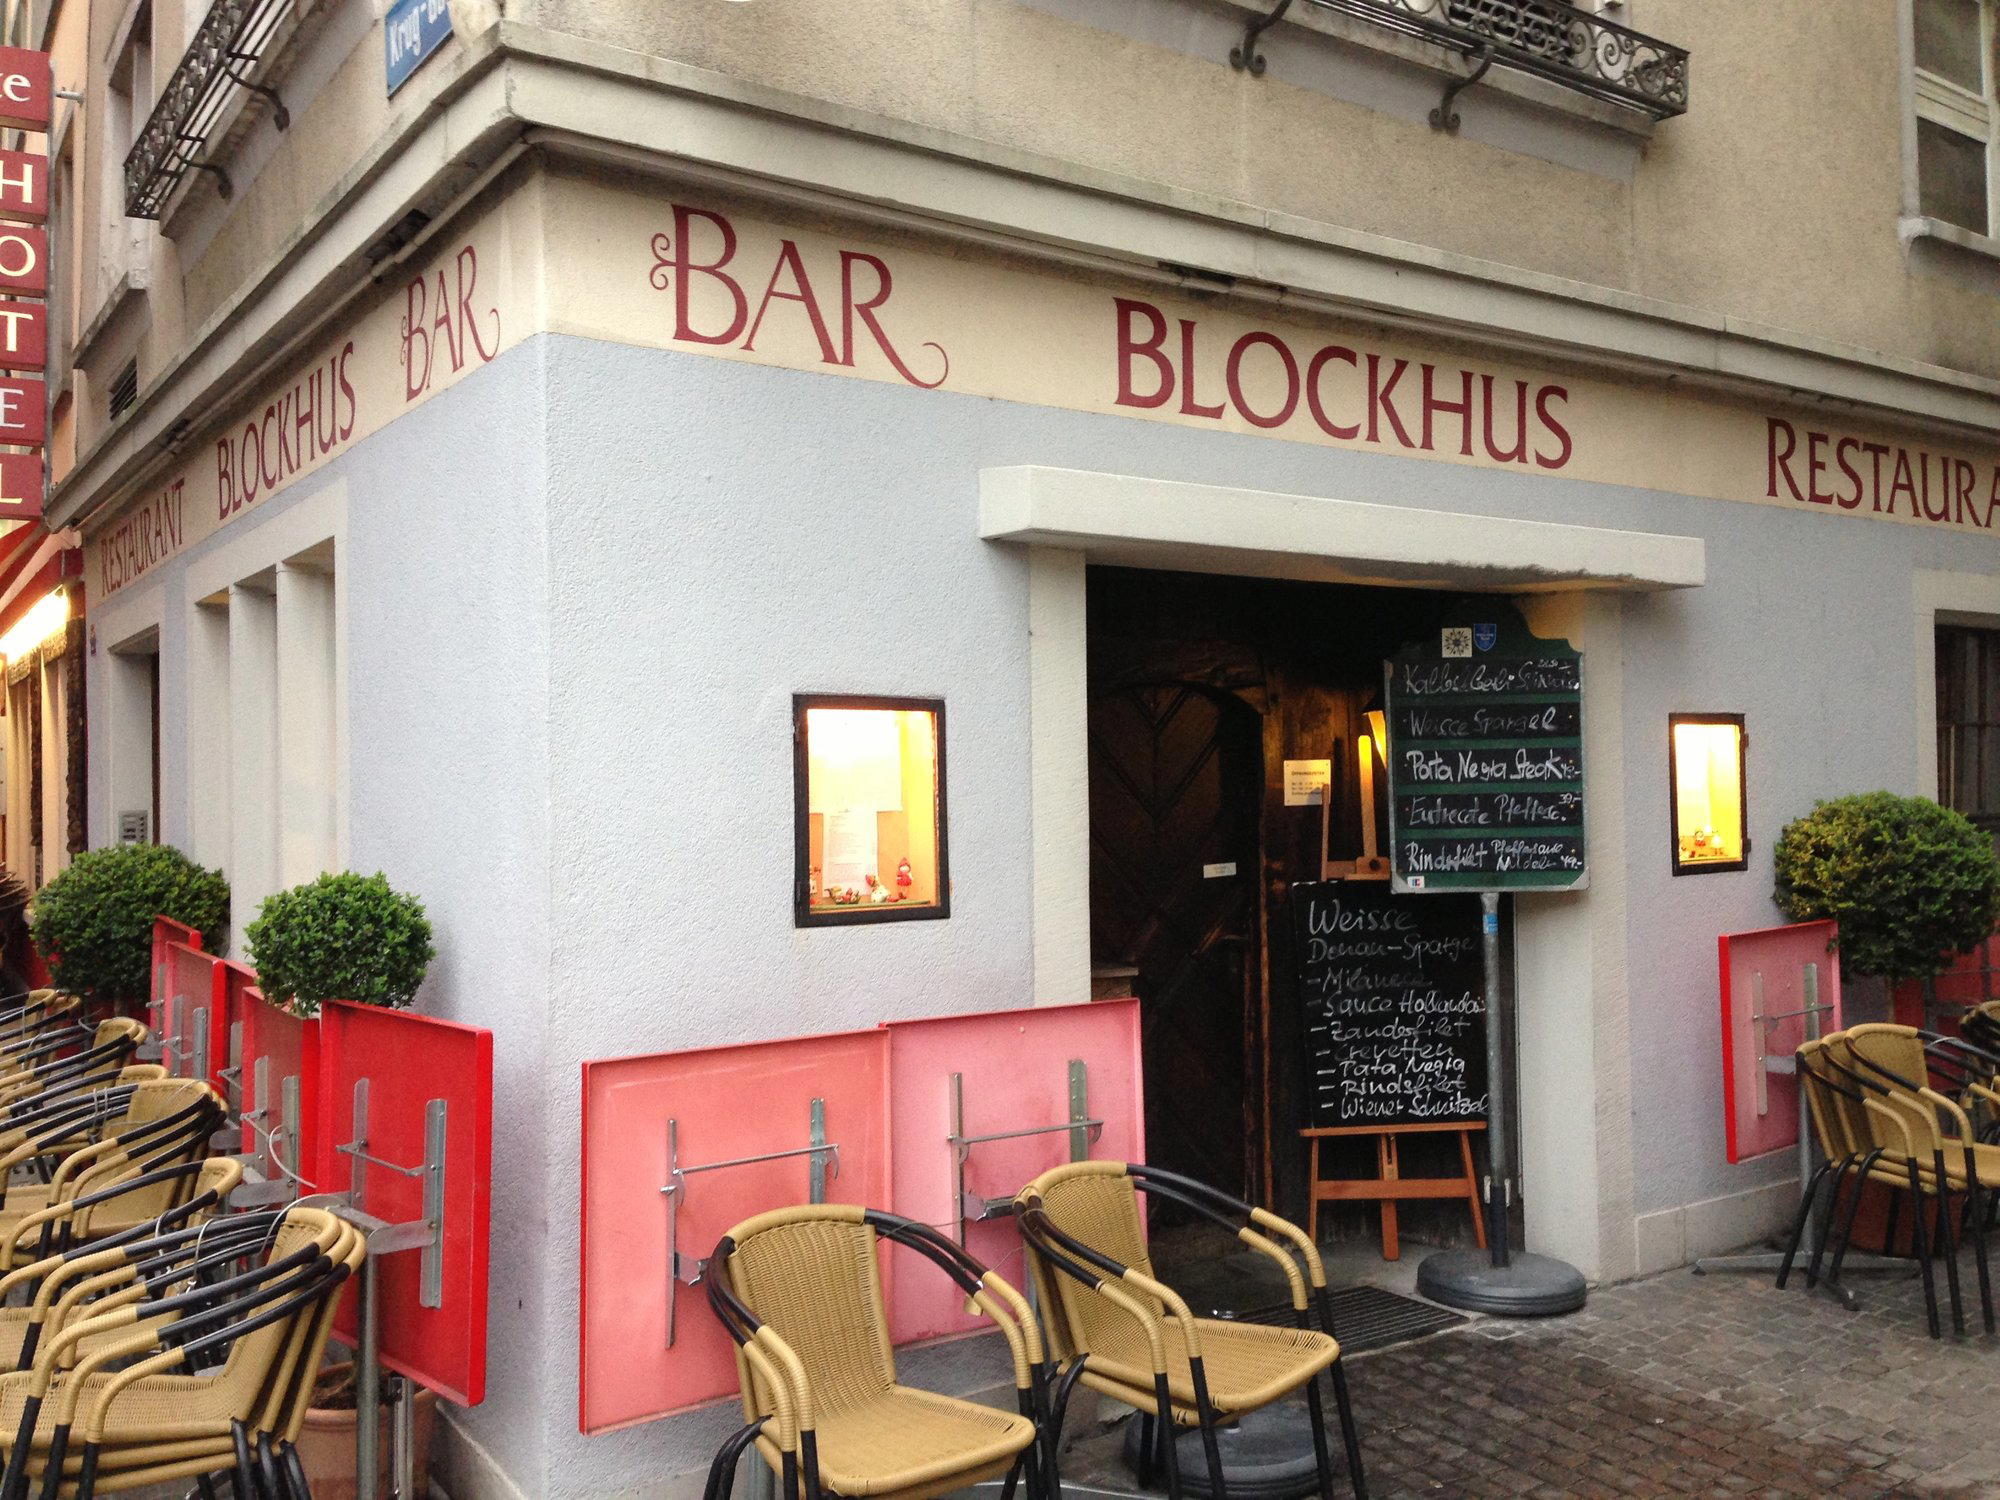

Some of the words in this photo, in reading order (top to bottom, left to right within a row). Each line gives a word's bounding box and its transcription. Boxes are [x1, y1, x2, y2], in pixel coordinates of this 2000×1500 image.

[0, 163, 36, 504] HOTEL
[400, 245, 500, 402] BAR
[650, 203, 948, 389] BAR
[1113, 297, 1572, 469] BLOCKHUS
[100, 477, 185, 596] RESTAURANT
[216, 341, 356, 521] BLOCKHUS
[1406, 750, 1453, 782] Pata
[1457, 750, 1507, 782] Negra
[1510, 748, 1562, 780] Steak
[1309, 899, 1418, 935] Weisse
[1323, 990, 1392, 1017] Sauce
[1340, 1058, 1397, 1077] Pata
[1405, 1056, 1466, 1077] Negra
[1341, 1073, 1467, 1095] Rindsfilet
[1341, 1096, 1403, 1119] Wiener
